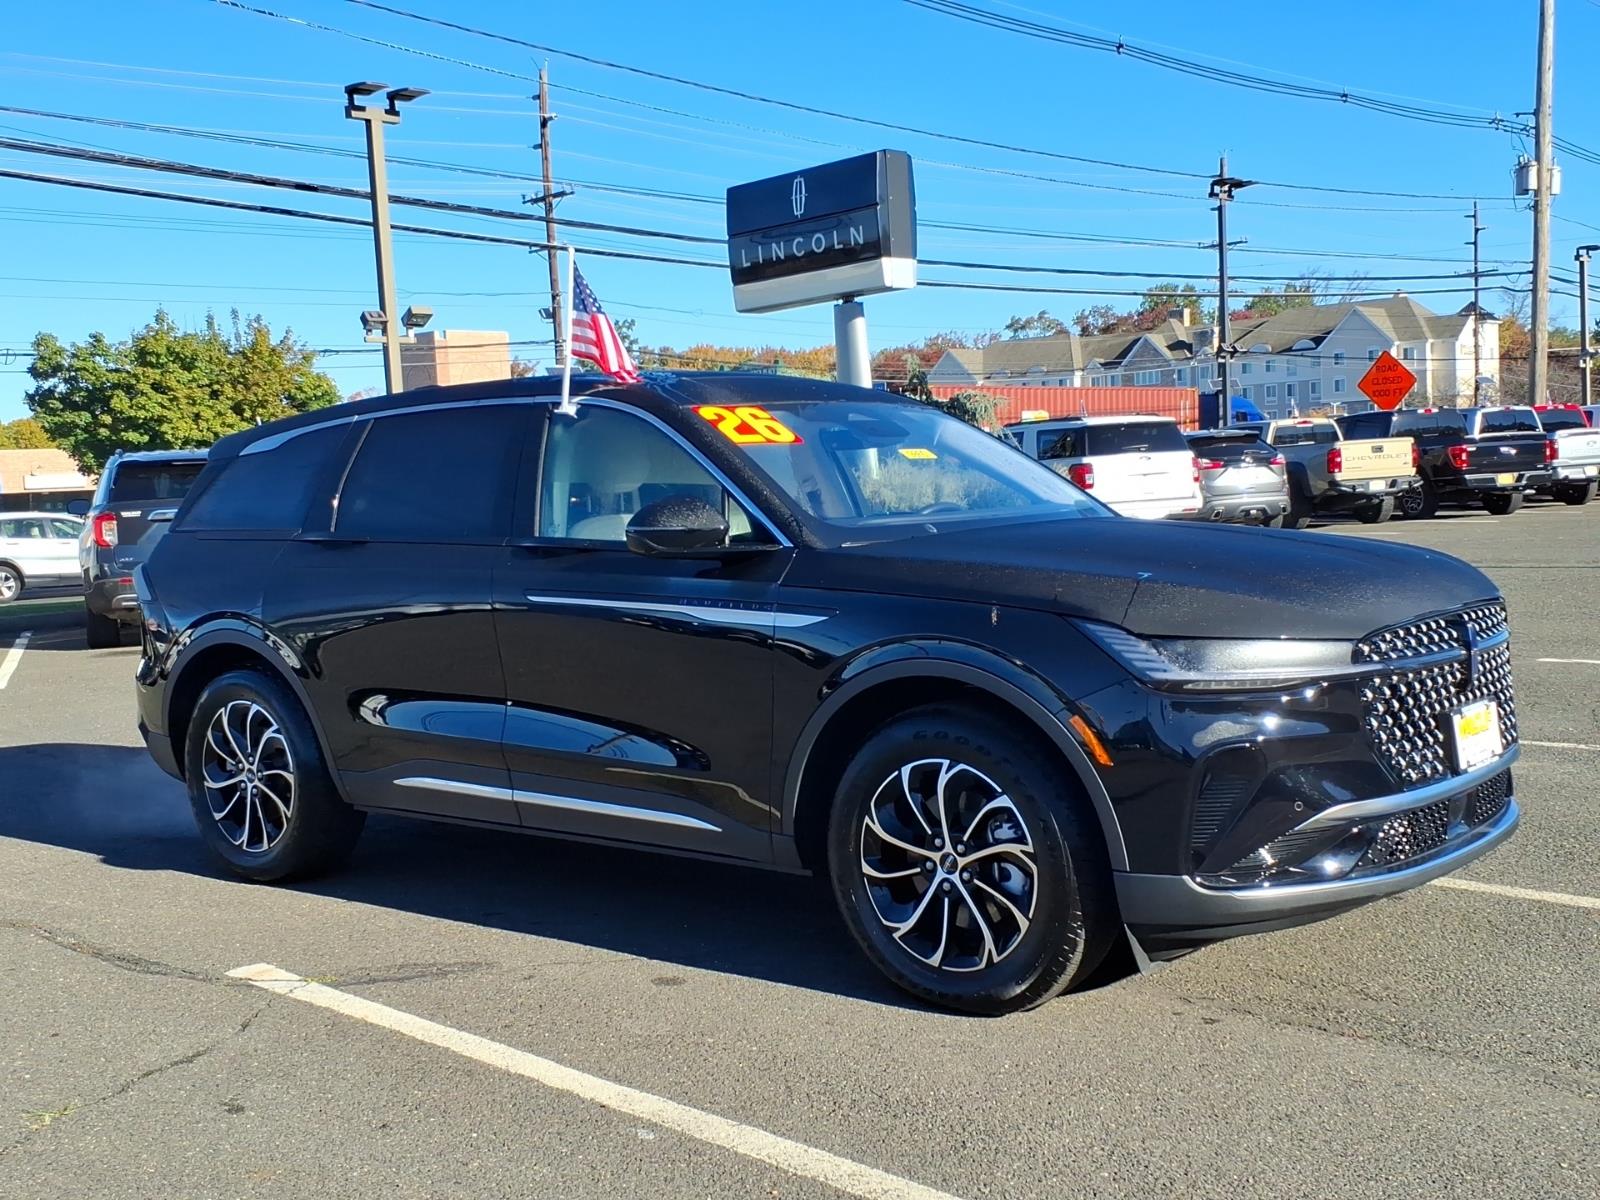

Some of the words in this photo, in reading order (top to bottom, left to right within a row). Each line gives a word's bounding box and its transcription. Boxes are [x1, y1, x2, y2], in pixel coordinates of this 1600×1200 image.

[741, 224, 864, 268] LINCOLN
[1375, 363, 1399, 374] ROAD
[1371, 375, 1403, 386] CLOSED
[1392, 387, 1404, 398] FT
[697, 405, 797, 444] 26
[1344, 452, 1410, 463] CHEVROLET
